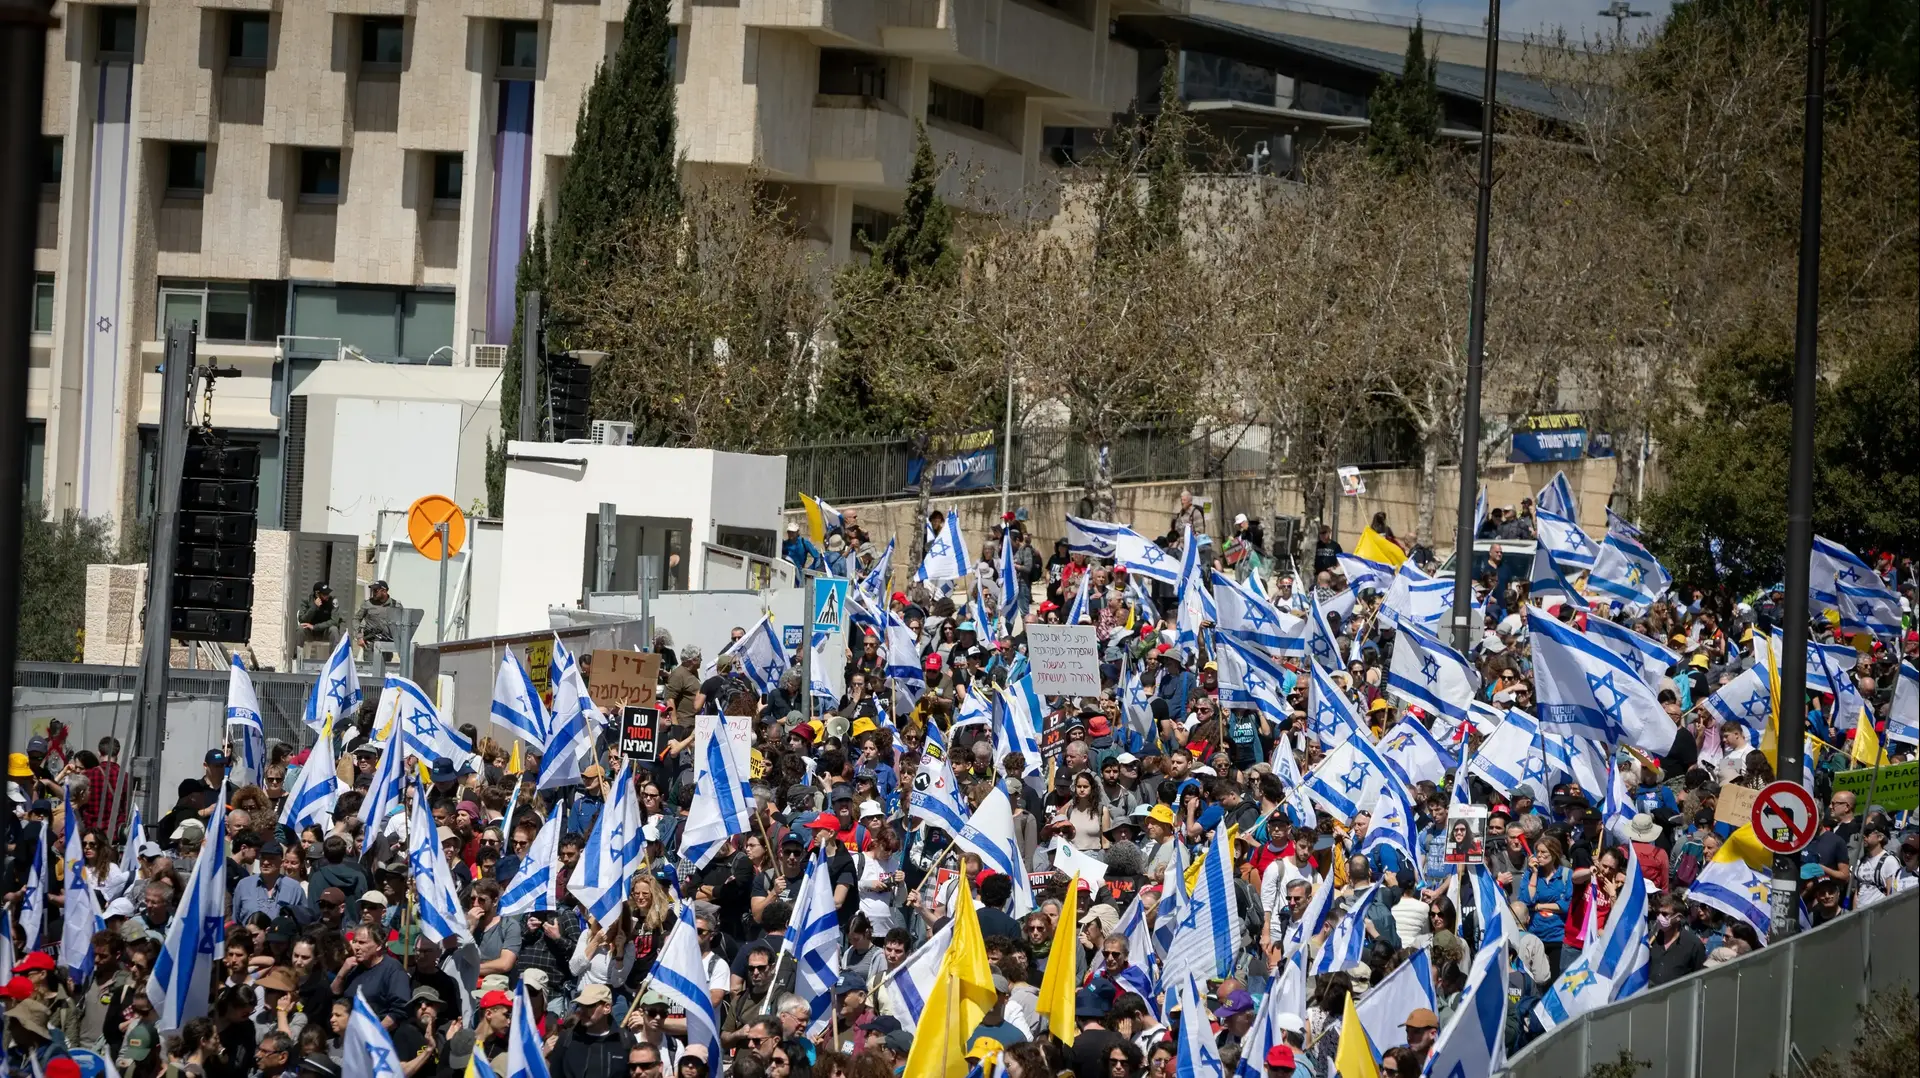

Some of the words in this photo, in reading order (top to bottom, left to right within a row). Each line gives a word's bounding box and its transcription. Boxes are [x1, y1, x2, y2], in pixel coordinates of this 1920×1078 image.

[590, 680, 652, 704] למלחמה
[633, 713, 648, 726] עם
[627, 726, 652, 739] חטוף
[1047, 730, 1059, 745] לא
[623, 739, 653, 752] בארצו
[1839, 773, 1877, 785] SAUD
[1885, 766, 1918, 779] PEAC
[1848, 780, 1919, 796] NIIATIVE
